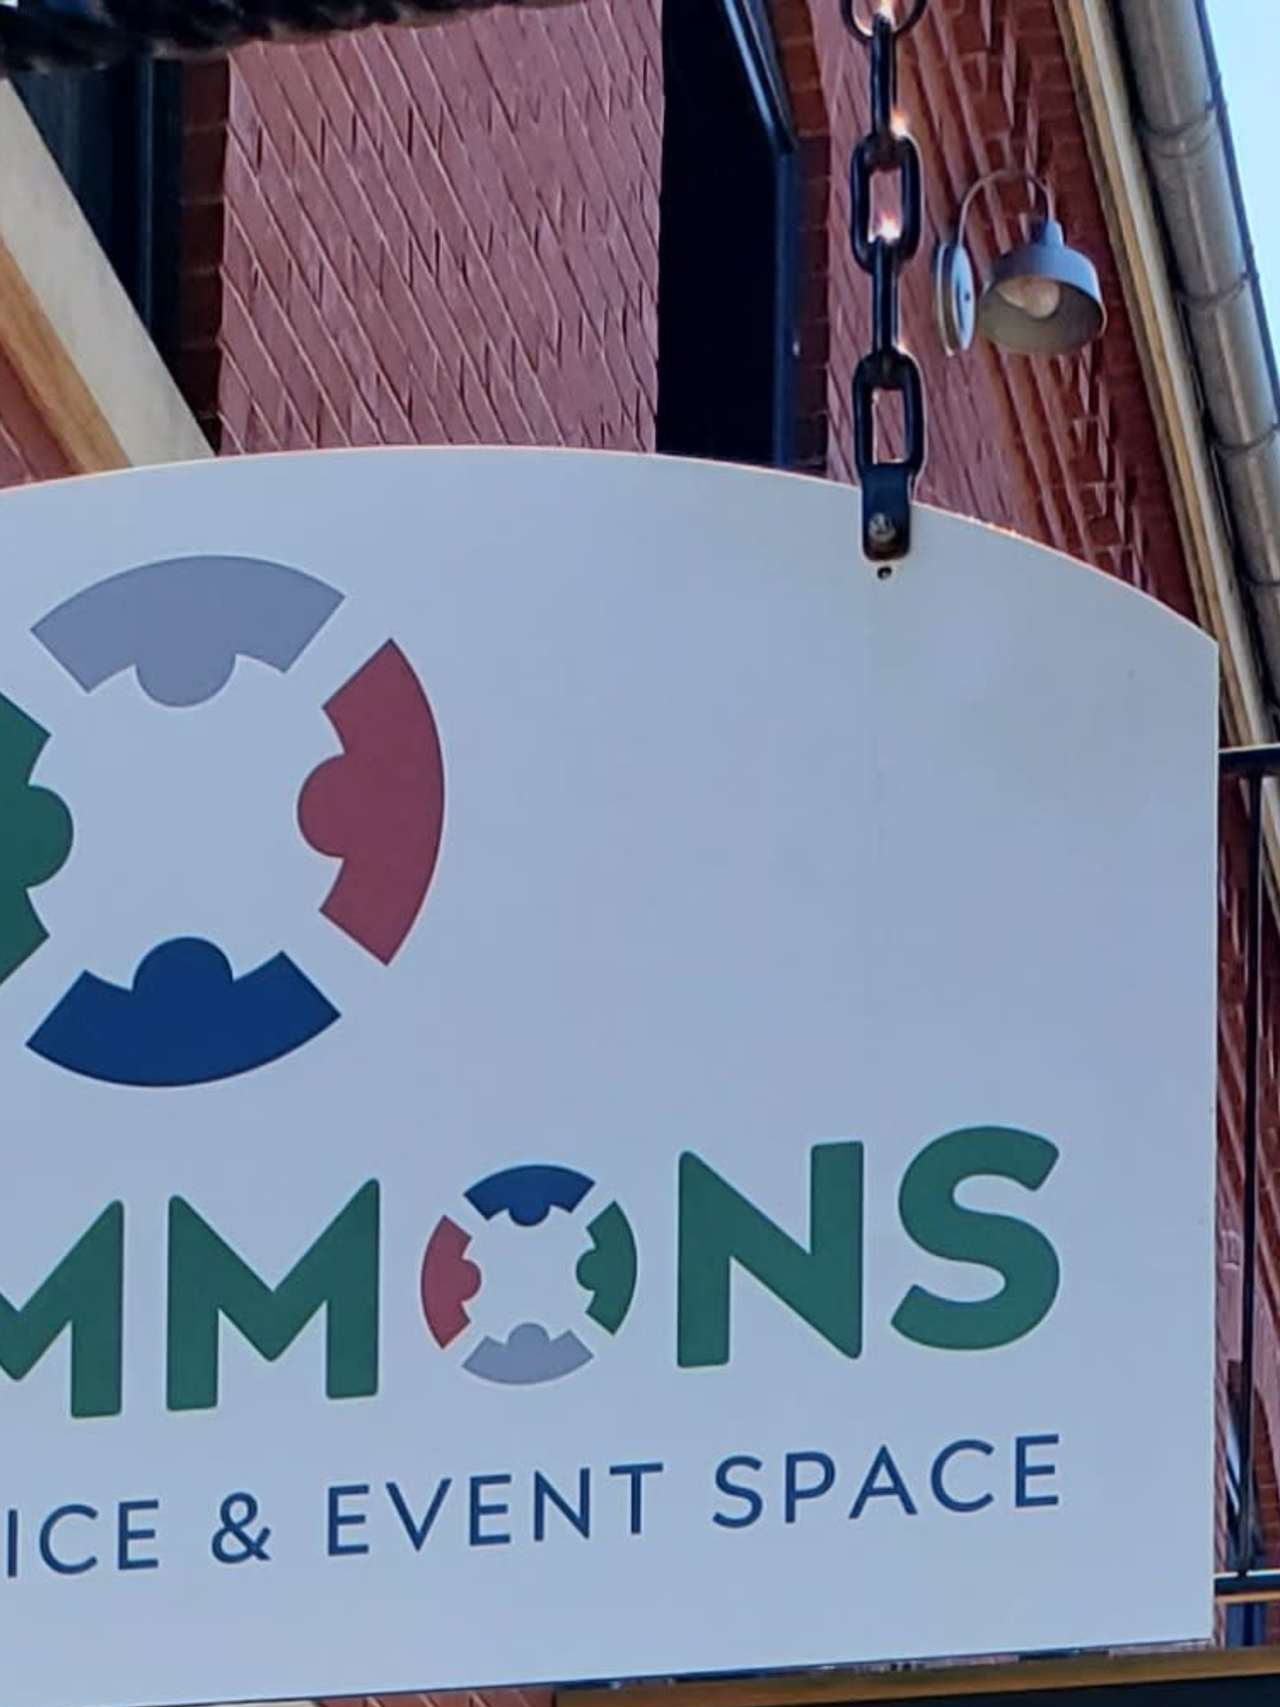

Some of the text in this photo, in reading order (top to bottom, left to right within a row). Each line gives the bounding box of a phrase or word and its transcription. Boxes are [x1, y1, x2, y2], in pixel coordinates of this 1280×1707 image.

[211, 1491, 271, 1565] &
[327, 1462, 664, 1557] EVENT
[712, 1433, 1060, 1529] SPACE
